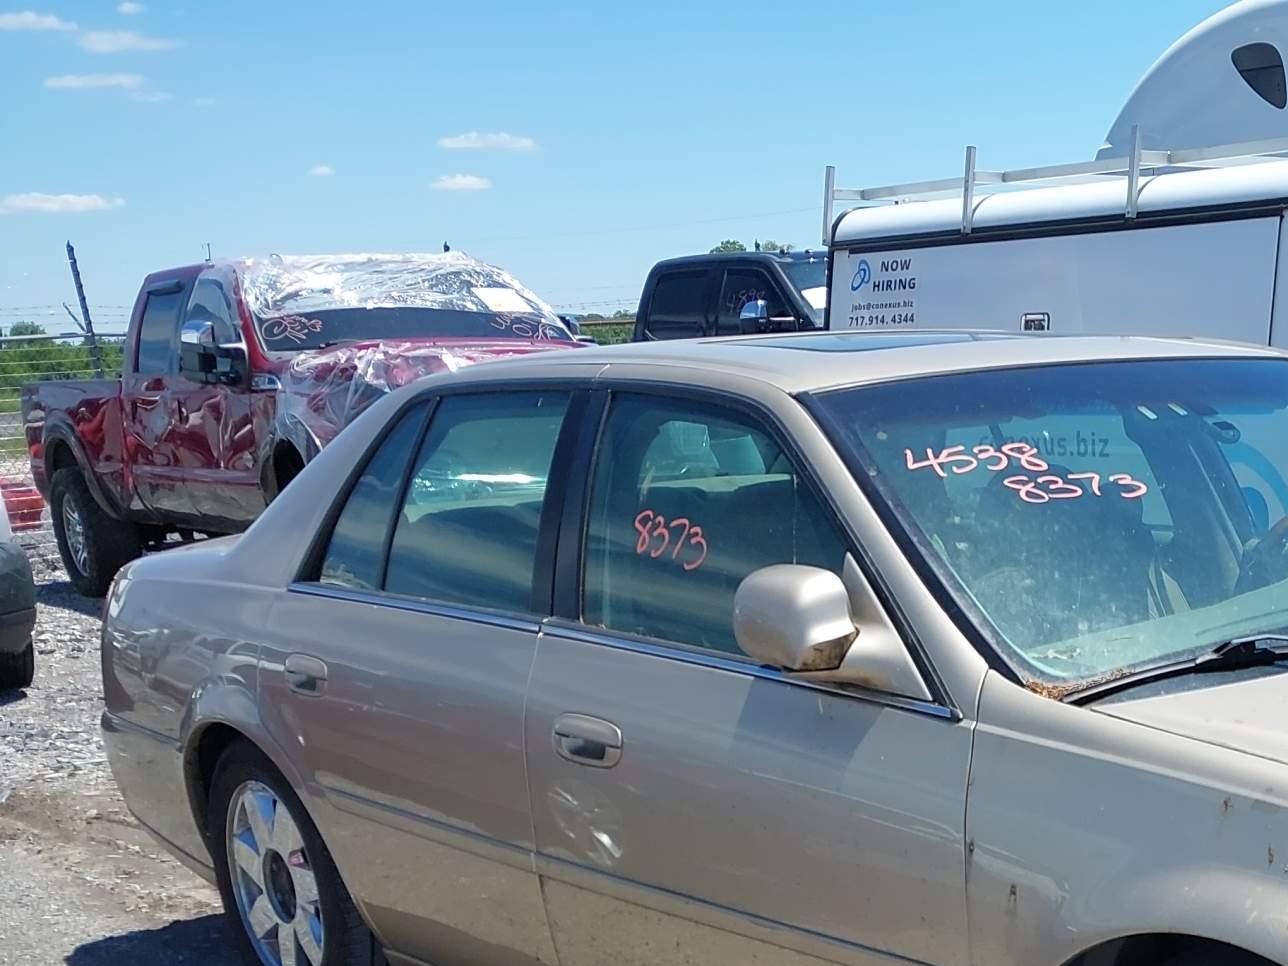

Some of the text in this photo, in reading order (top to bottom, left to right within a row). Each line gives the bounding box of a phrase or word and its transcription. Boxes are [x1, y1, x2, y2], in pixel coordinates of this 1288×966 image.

[880, 258, 912, 272] NOW
[872, 277, 916, 292] HIRING
[851, 299, 914, 312] jobs@conexus.biz
[904, 442, 1049, 477] 4538
[1003, 473, 1148, 503] 8373
[634, 509, 708, 571] 8373
